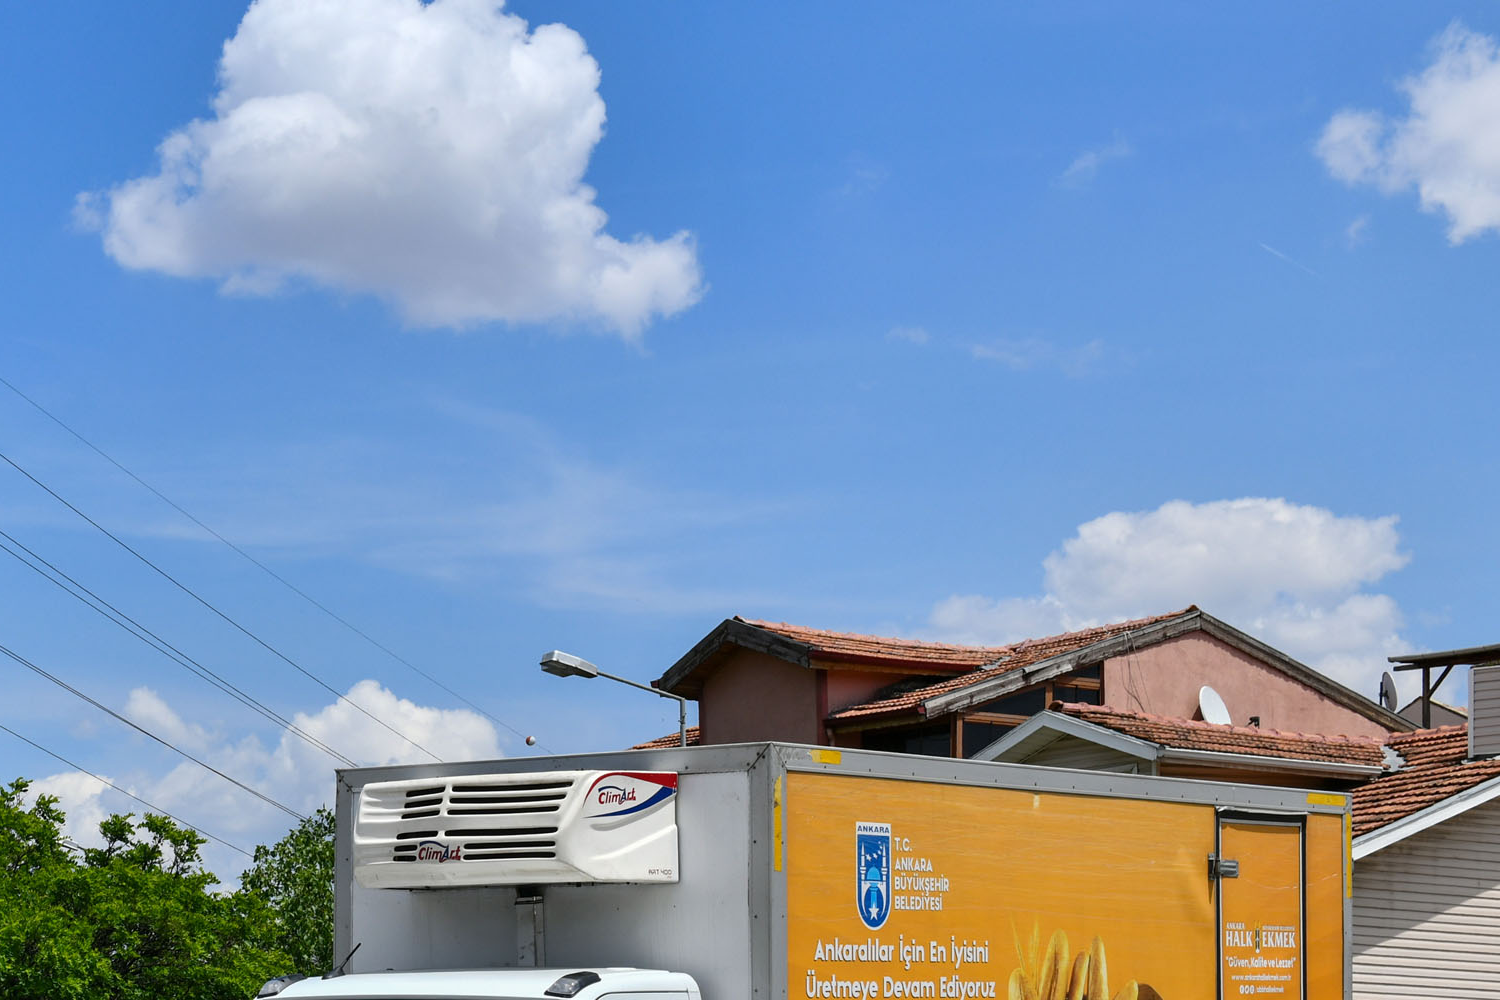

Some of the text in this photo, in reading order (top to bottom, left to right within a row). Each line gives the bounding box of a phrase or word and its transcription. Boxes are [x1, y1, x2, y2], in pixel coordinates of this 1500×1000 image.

[598, 787, 636, 805] ClimArt
[857, 825, 890, 834] ANKARA
[894, 837, 912, 851] T.C.
[418, 844, 461, 863] ClimArt
[894, 858, 933, 872] ANKARA
[894, 873, 949, 894] BÜYÜKŞEHİR
[894, 894, 943, 911] BELEDİYESİ
[1226, 930, 1296, 948] HALK EKMEK
[814, 934, 989, 969] Ankaralılar İçin En İyisini
[883, 976, 935, 998] Devam
